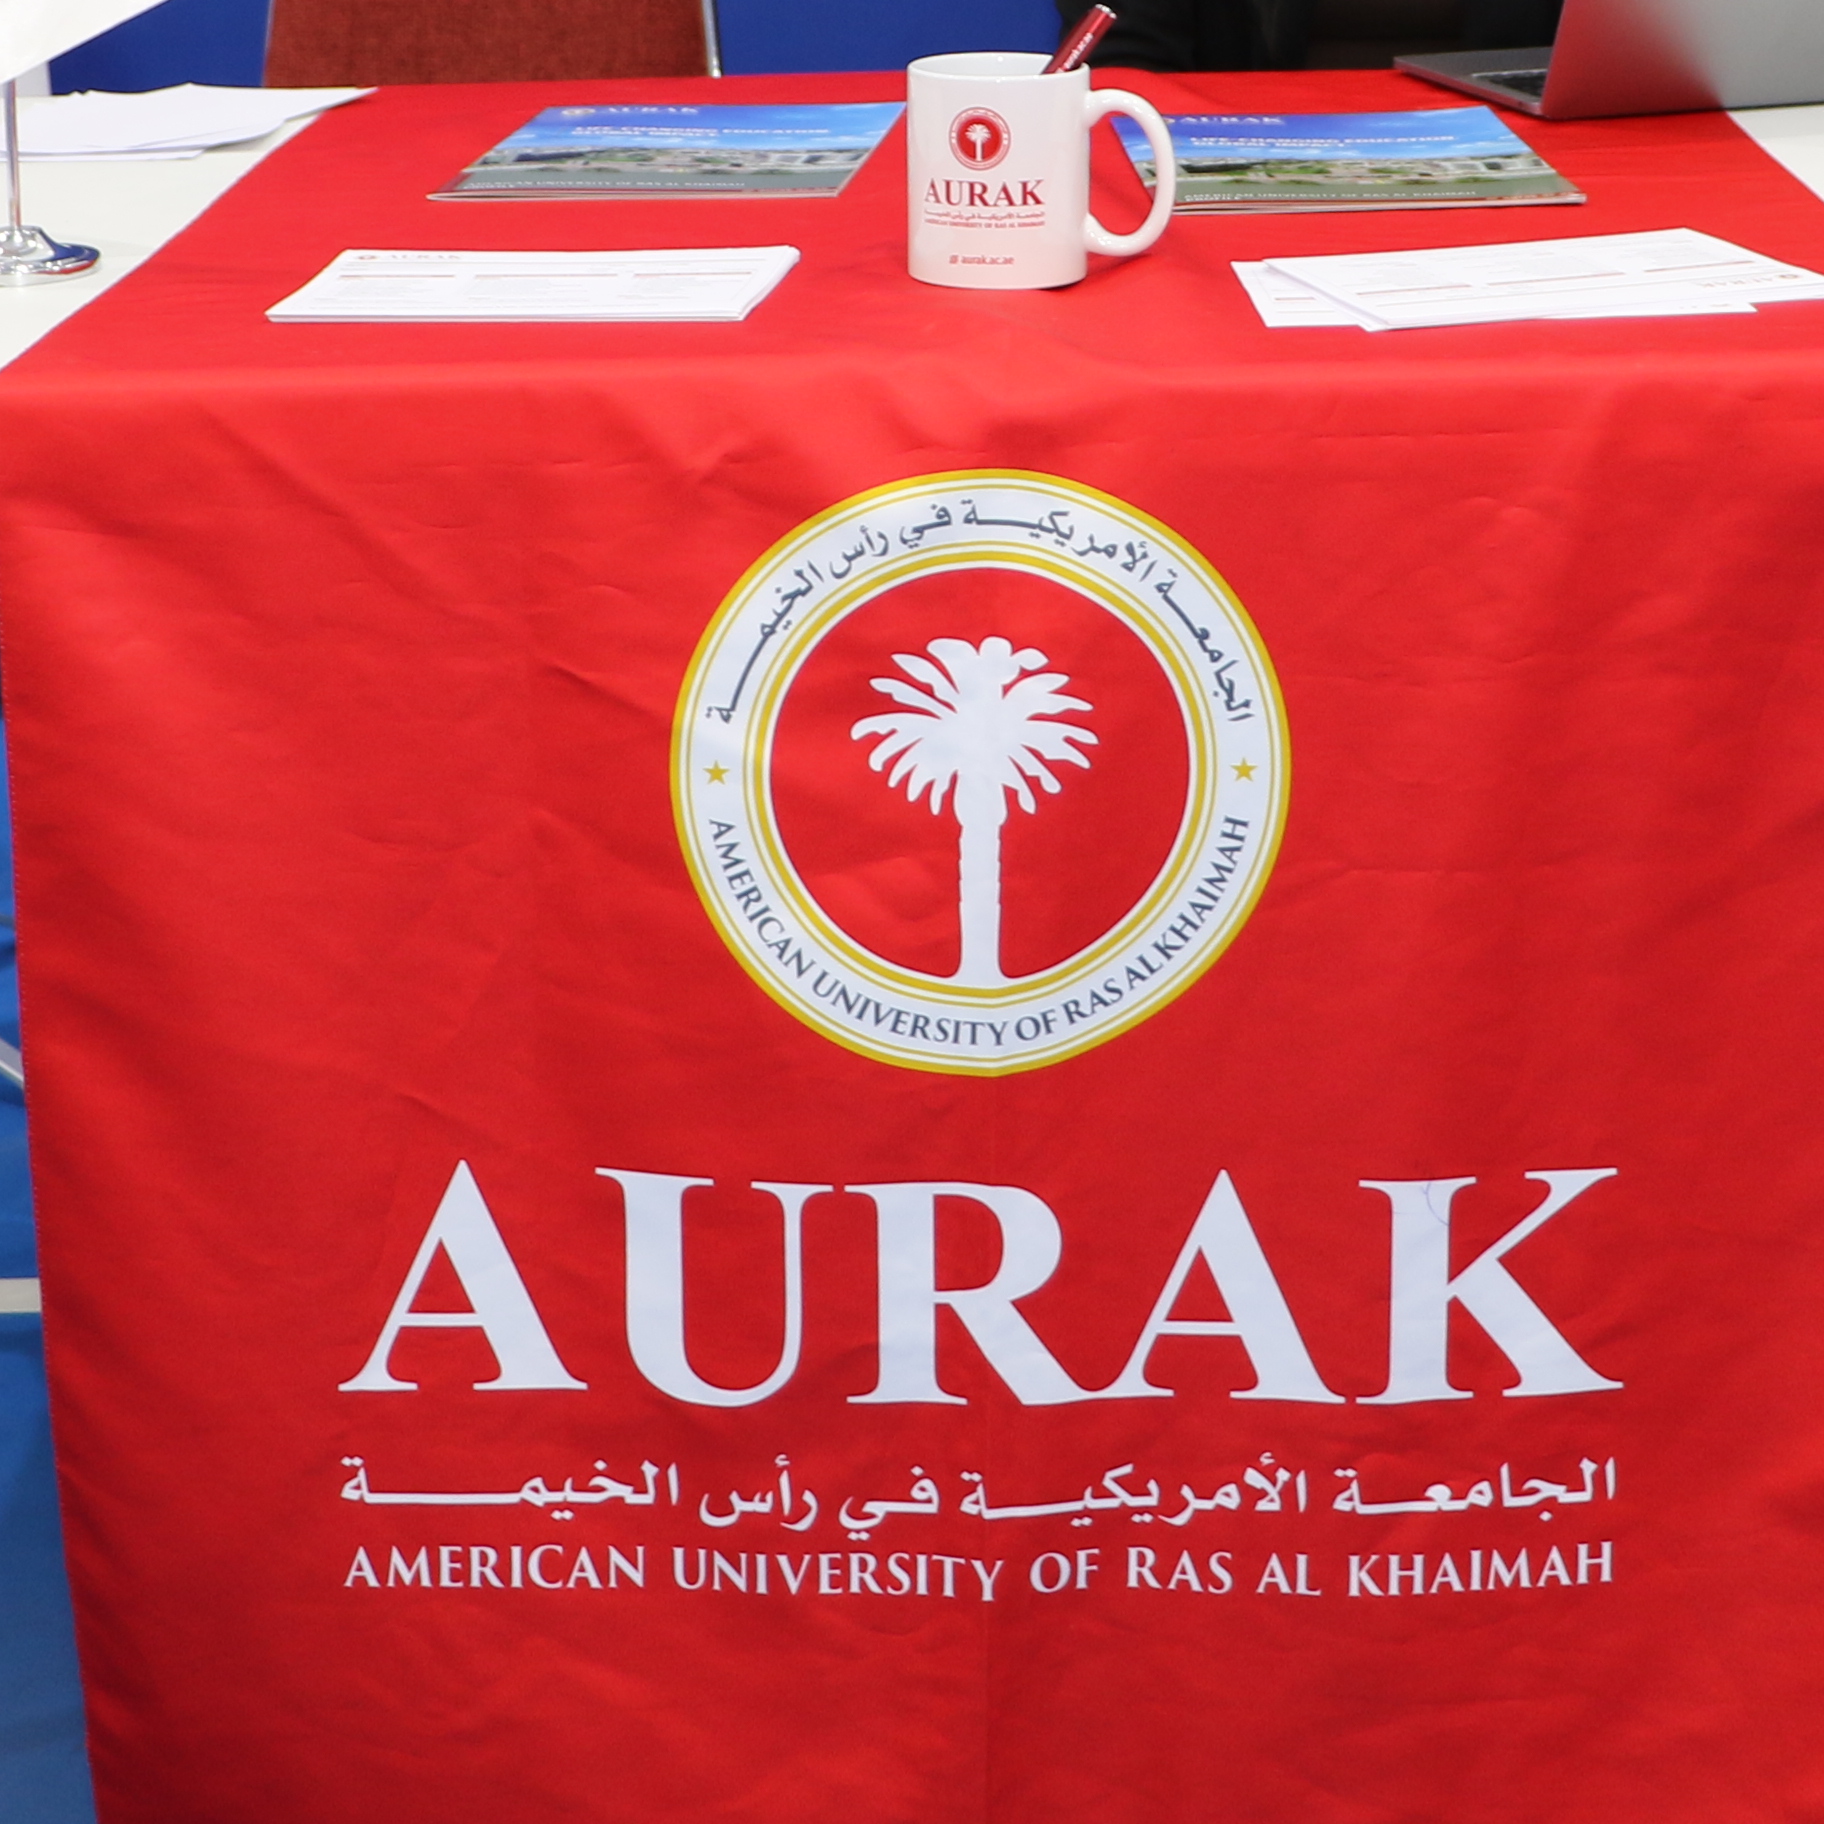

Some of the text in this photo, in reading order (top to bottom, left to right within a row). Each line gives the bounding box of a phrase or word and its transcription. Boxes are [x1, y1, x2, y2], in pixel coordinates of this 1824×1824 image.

[924, 177, 1045, 207] AURAK
[829, 525, 889, 580] رأس
[898, 503, 952, 549] في
[705, 560, 825, 724] الخيمة
[1153, 567, 1256, 722] الجامعة
[708, 815, 1252, 1047] AMERICAN UNIVERSITY OF RAS AL KHAIMAH
[337, 1159, 1625, 1408] AURAK
[338, 1450, 1617, 1541] الجامعة الأمريكية في رأس الخيمة
[342, 1539, 1616, 1603] AMERICAN UNIVERSITY OF RAS AL KHAIMAH
